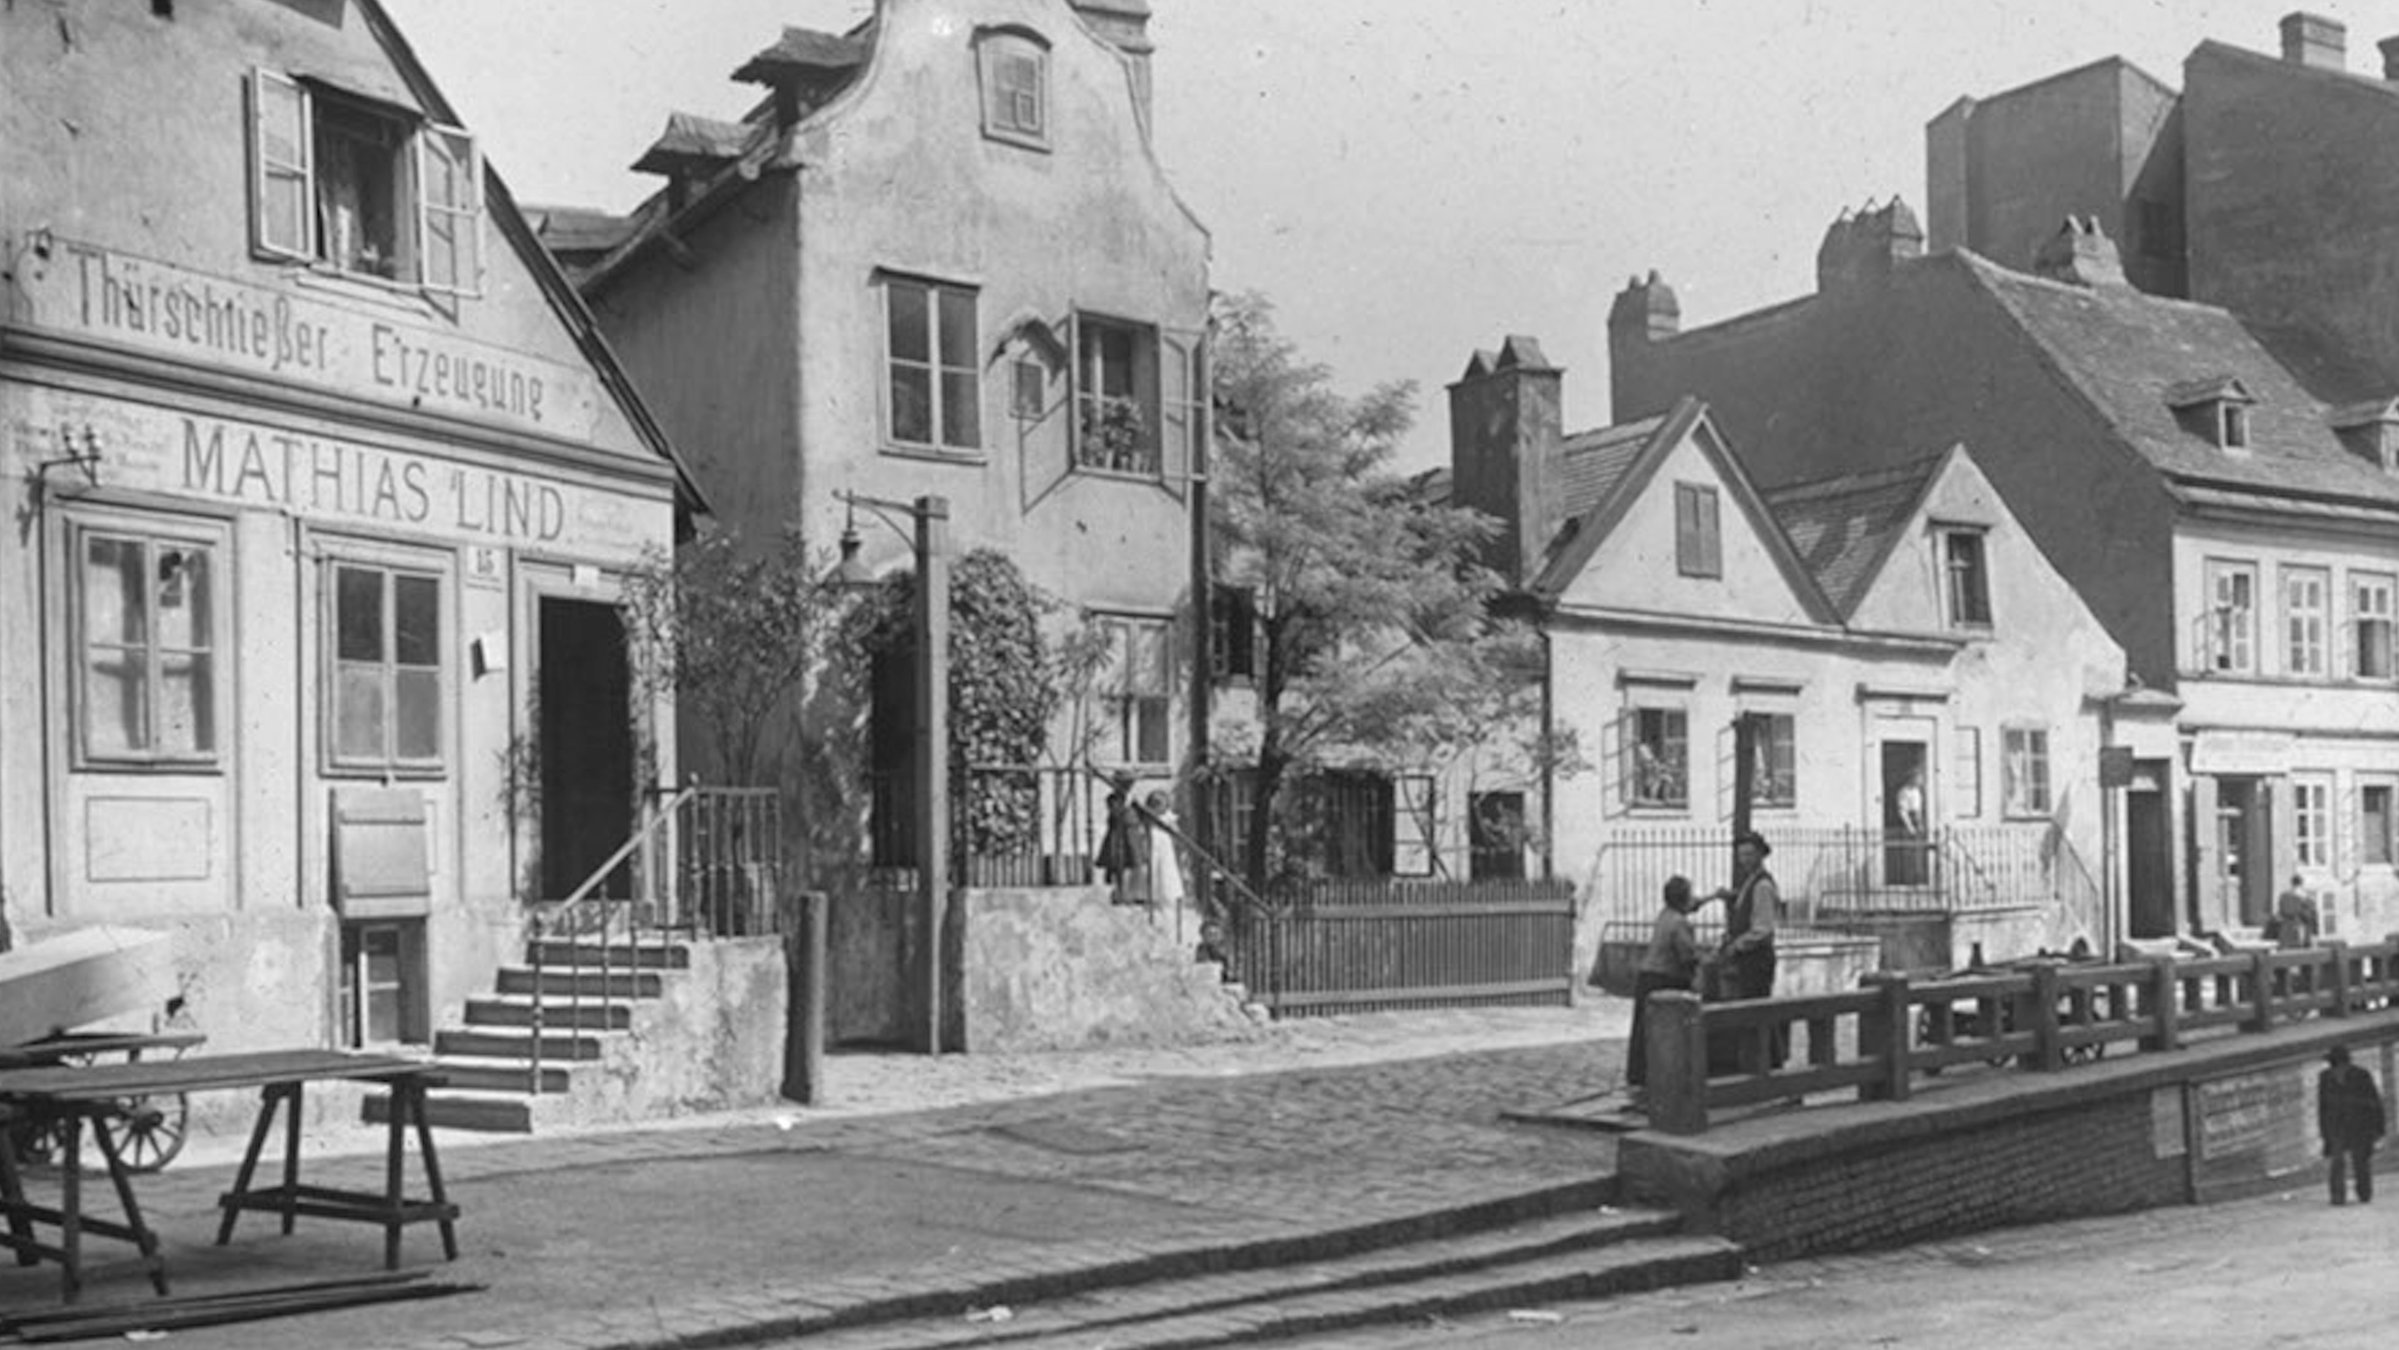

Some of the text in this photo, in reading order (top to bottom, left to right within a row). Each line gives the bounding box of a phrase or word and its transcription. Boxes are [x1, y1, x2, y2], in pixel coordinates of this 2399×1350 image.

[372, 323, 544, 422] Erzeugung
[181, 417, 430, 522] MATHIAS
[456, 471, 564, 541] LIND
